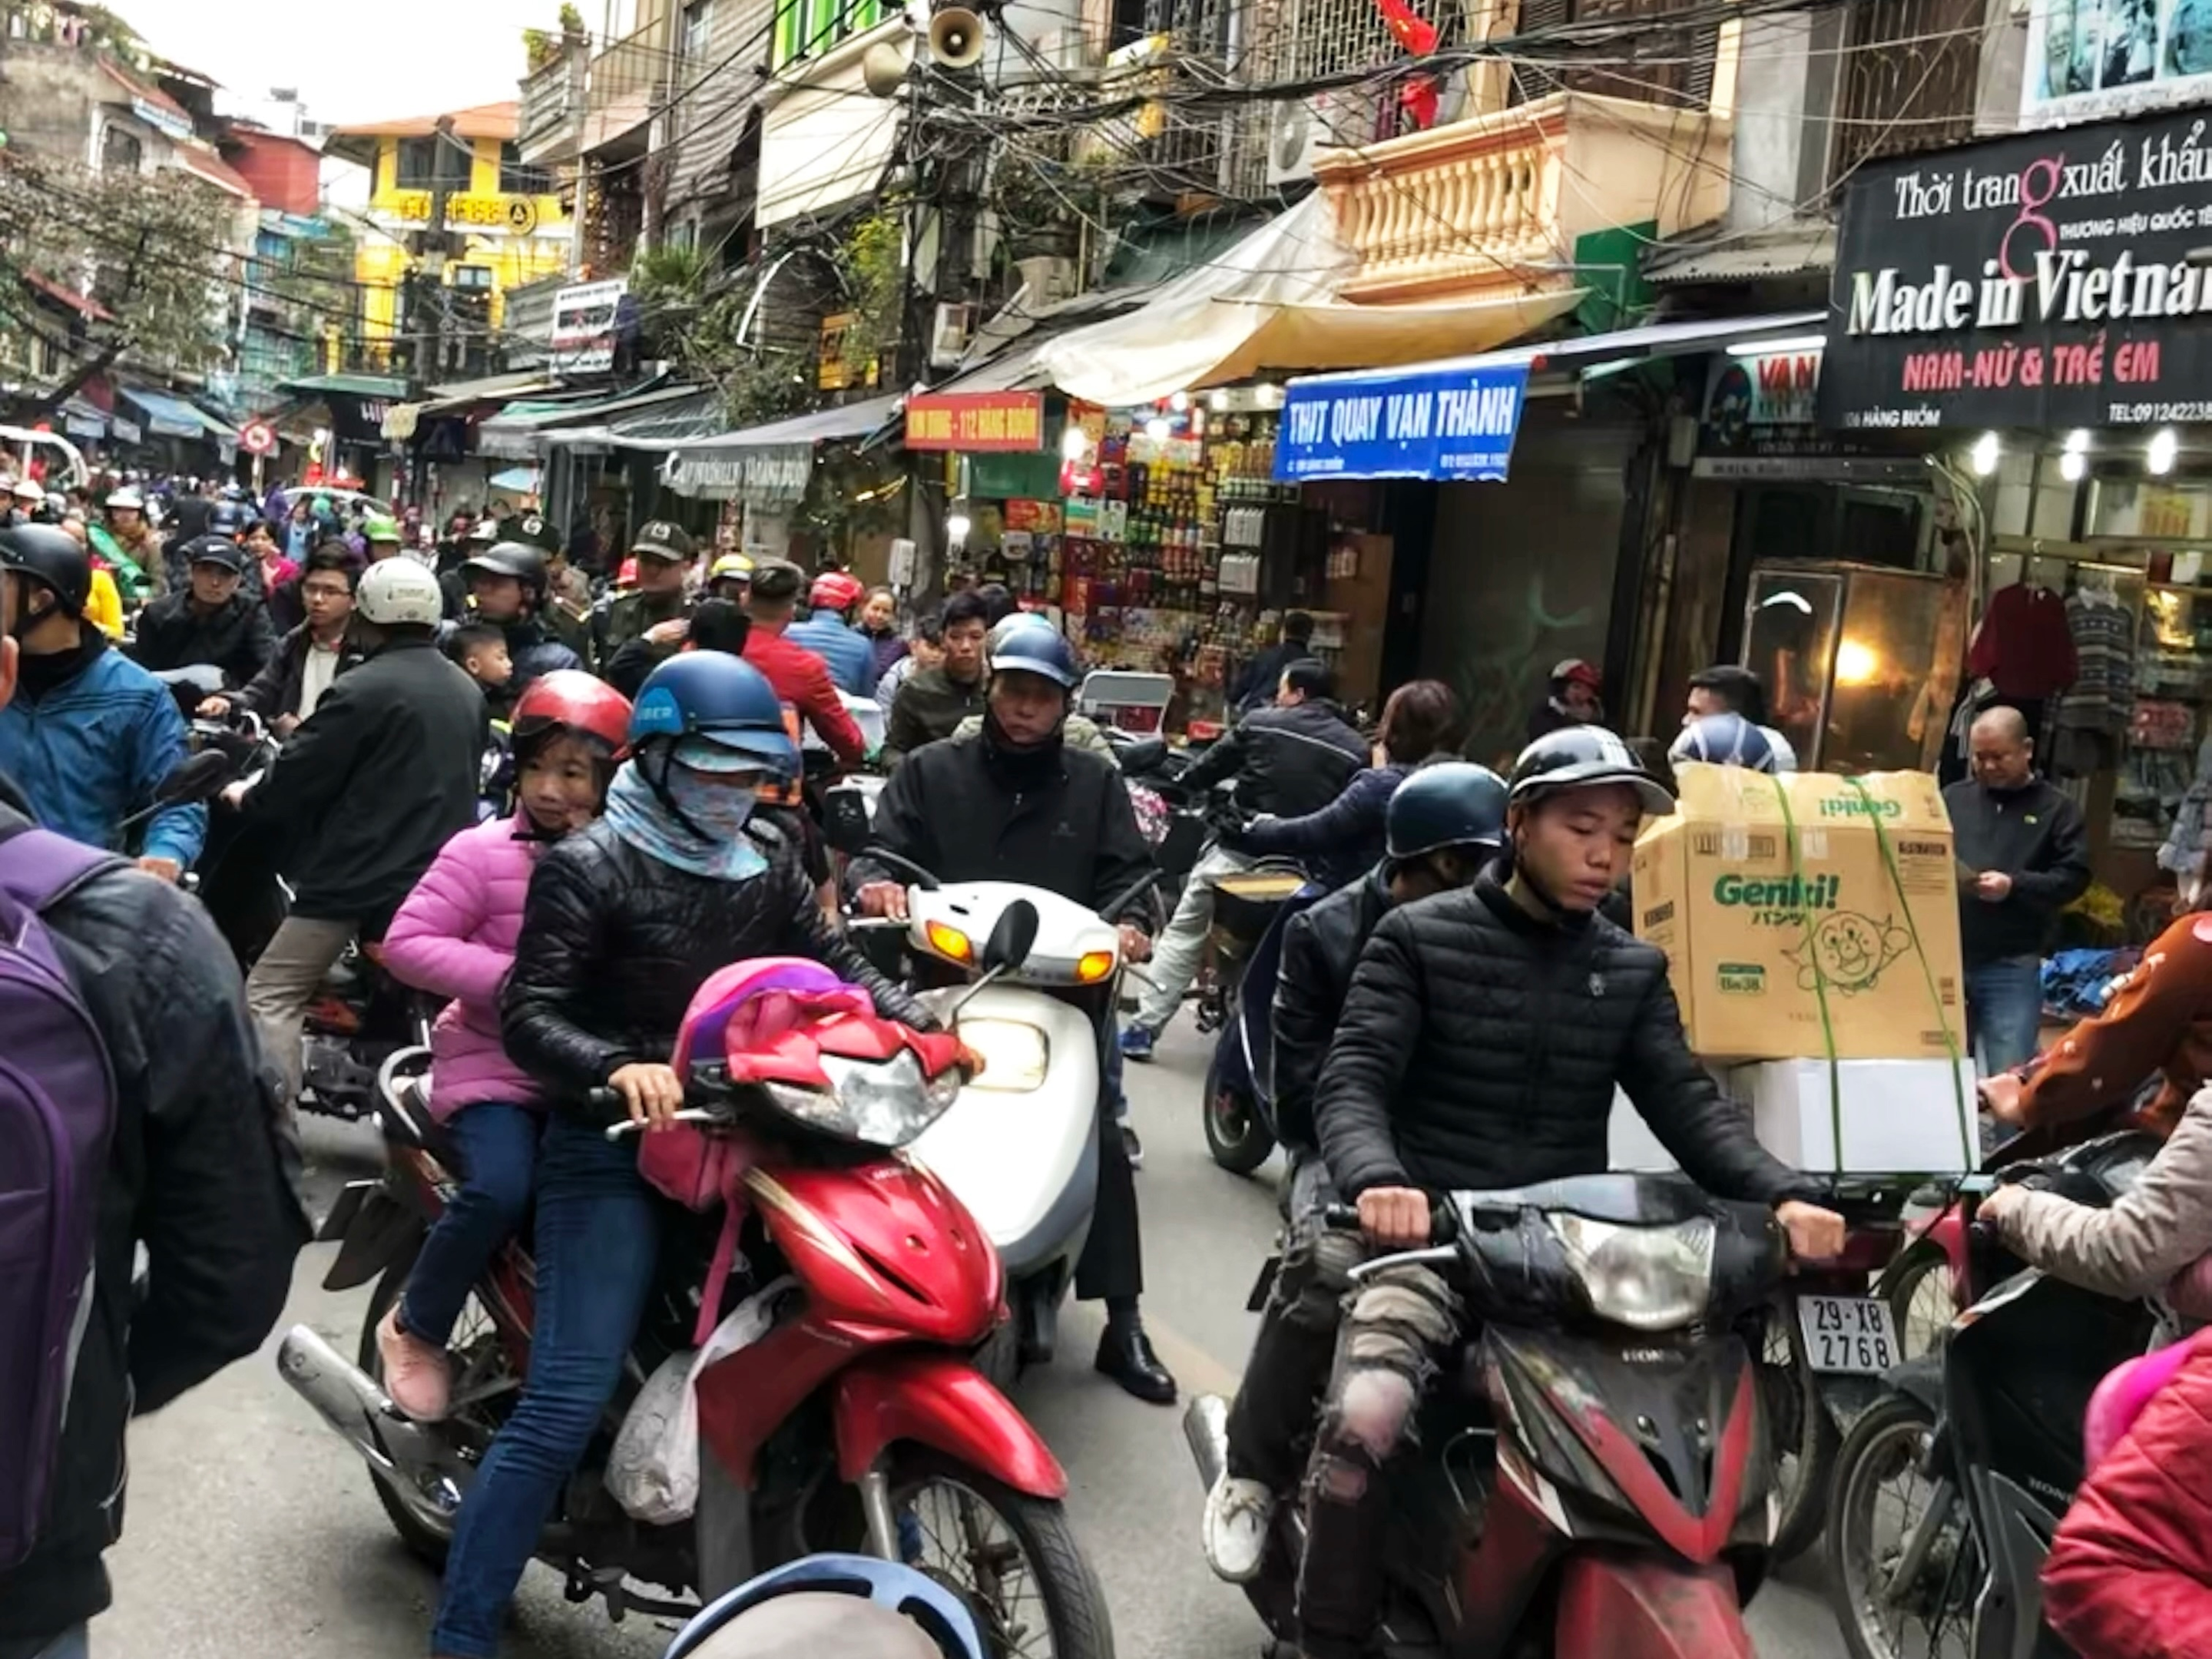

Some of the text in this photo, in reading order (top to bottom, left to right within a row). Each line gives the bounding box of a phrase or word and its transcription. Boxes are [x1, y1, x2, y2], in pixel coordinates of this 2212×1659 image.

[1896, 171, 1955, 220] Thời
[2058, 139, 2128, 199] xuất
[1846, 263, 1974, 336] Made
[1975, 257, 2025, 327] in
[2019, 347, 2044, 386] &
[2112, 341, 2161, 382] EM
[1289, 377, 1517, 452] THỊT QUAY VẠN THÀNH
[1714, 873, 1840, 909] Genki!
[1820, 1334, 1890, 1369] 2768
[2025, 1475, 2074, 1503] HON
